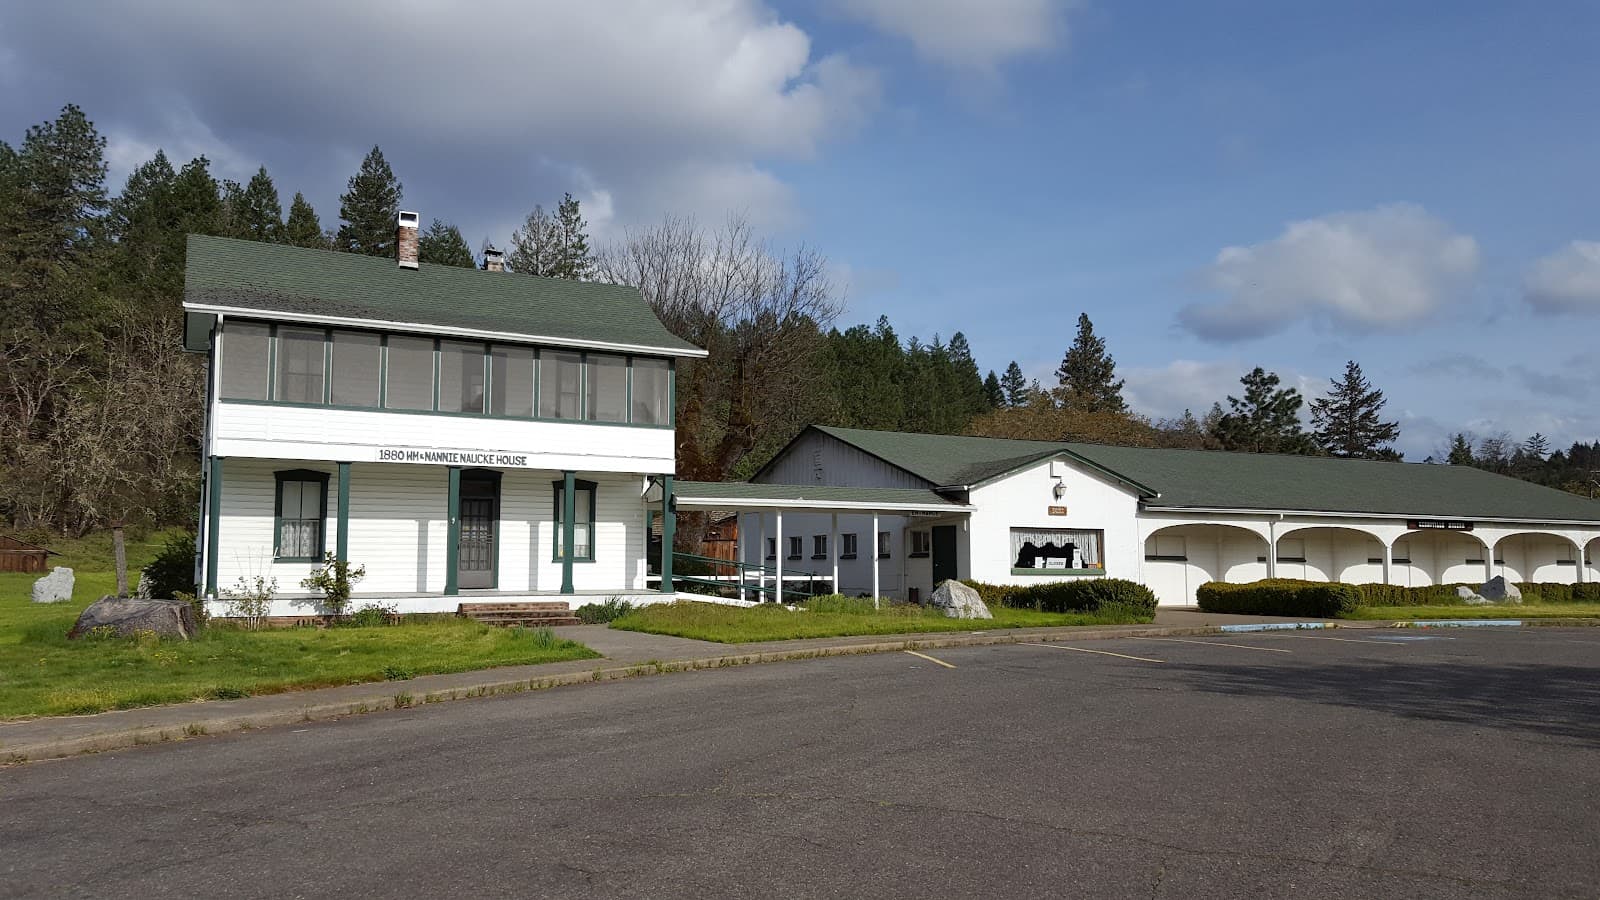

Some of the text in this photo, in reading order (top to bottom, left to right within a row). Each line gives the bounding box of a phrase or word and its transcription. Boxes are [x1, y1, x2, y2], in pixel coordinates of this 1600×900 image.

[379, 449, 405, 461] 1880
[425, 451, 459, 463] NANNIE
[459, 453, 495, 465] NAUCKE
[496, 455, 528, 466] HOUSE
